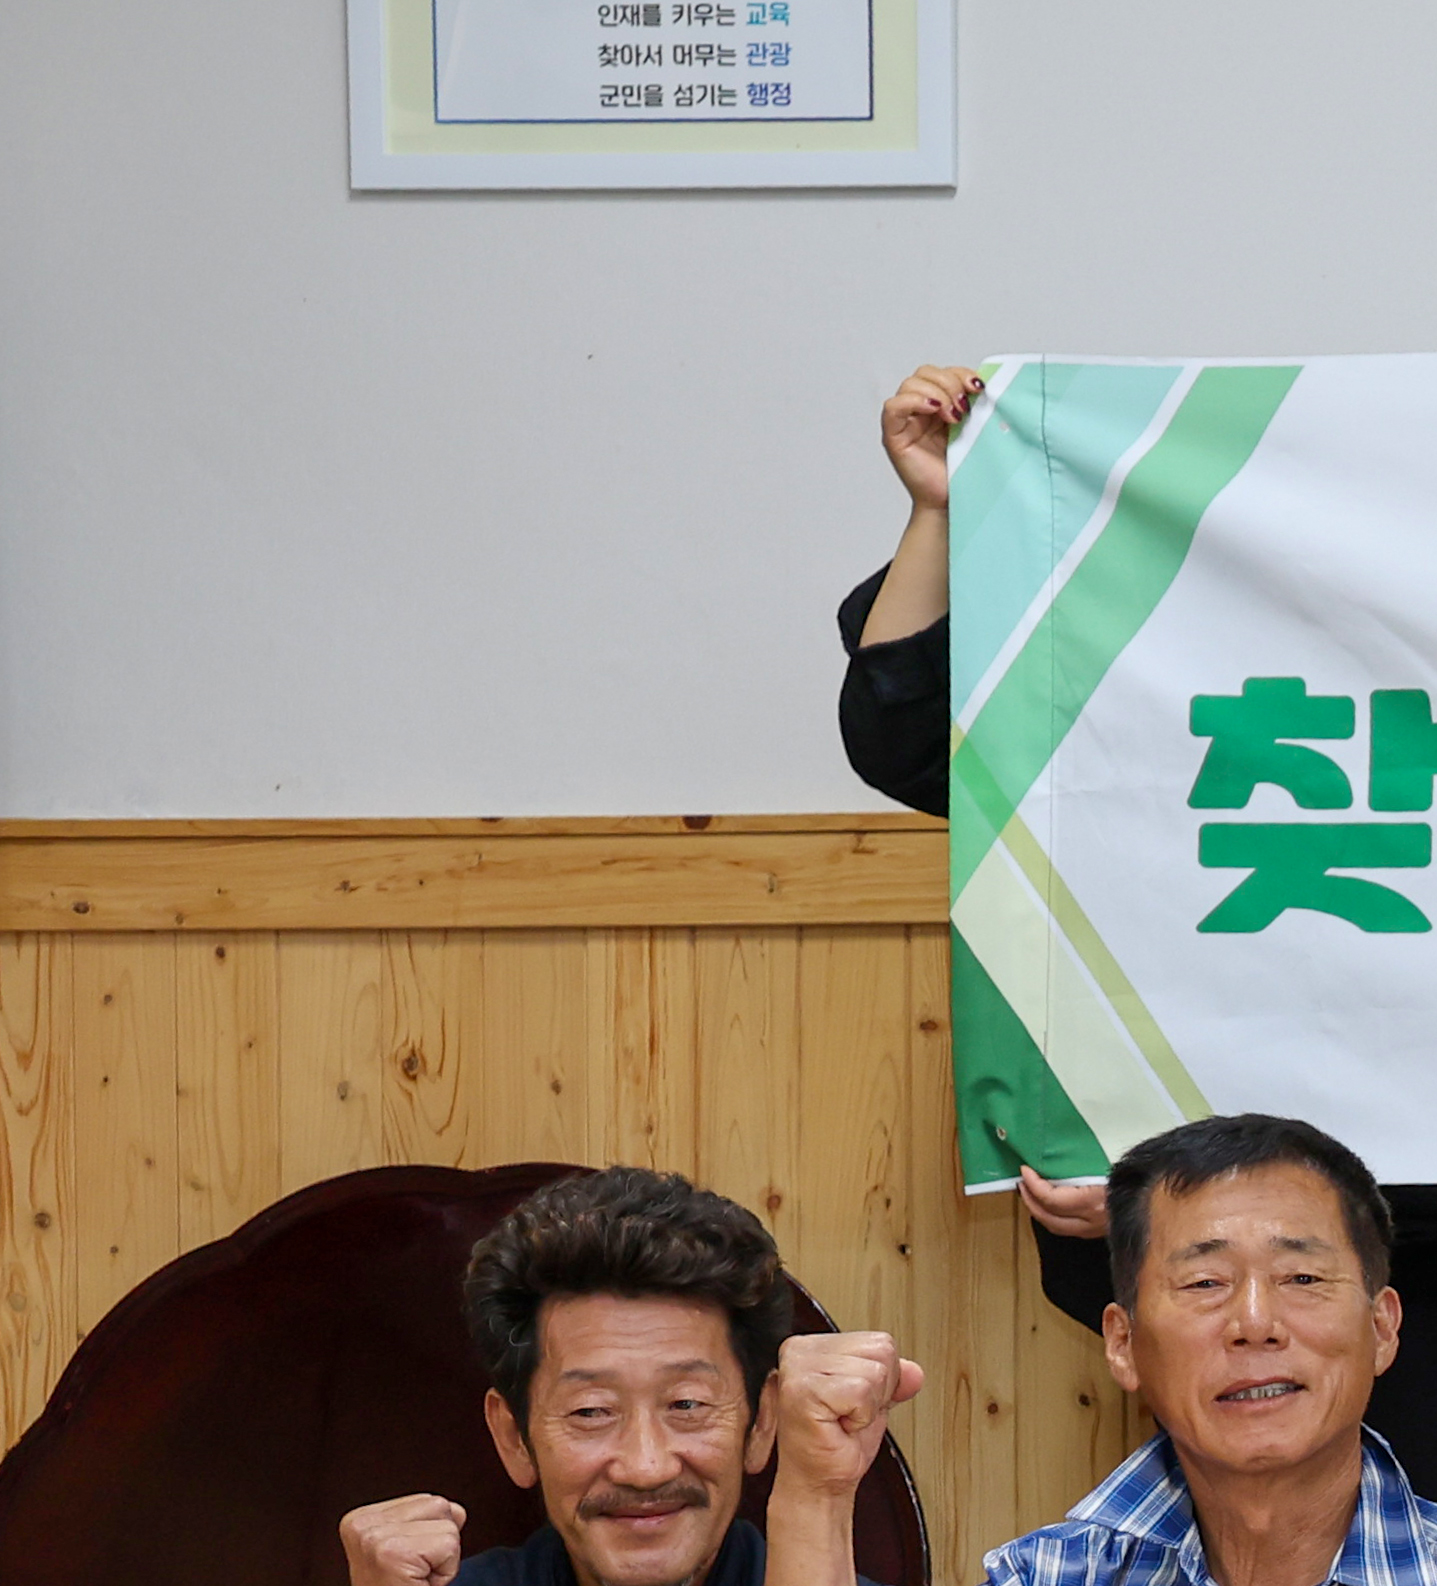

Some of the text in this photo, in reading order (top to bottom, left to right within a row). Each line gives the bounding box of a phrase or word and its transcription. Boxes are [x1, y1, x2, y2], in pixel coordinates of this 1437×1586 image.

[598, 2, 790, 27] 인재를 키우는 교육
[598, 42, 792, 68] 찾아서 머무는 관광
[599, 82, 792, 108] 군민을 섬기는 행정
